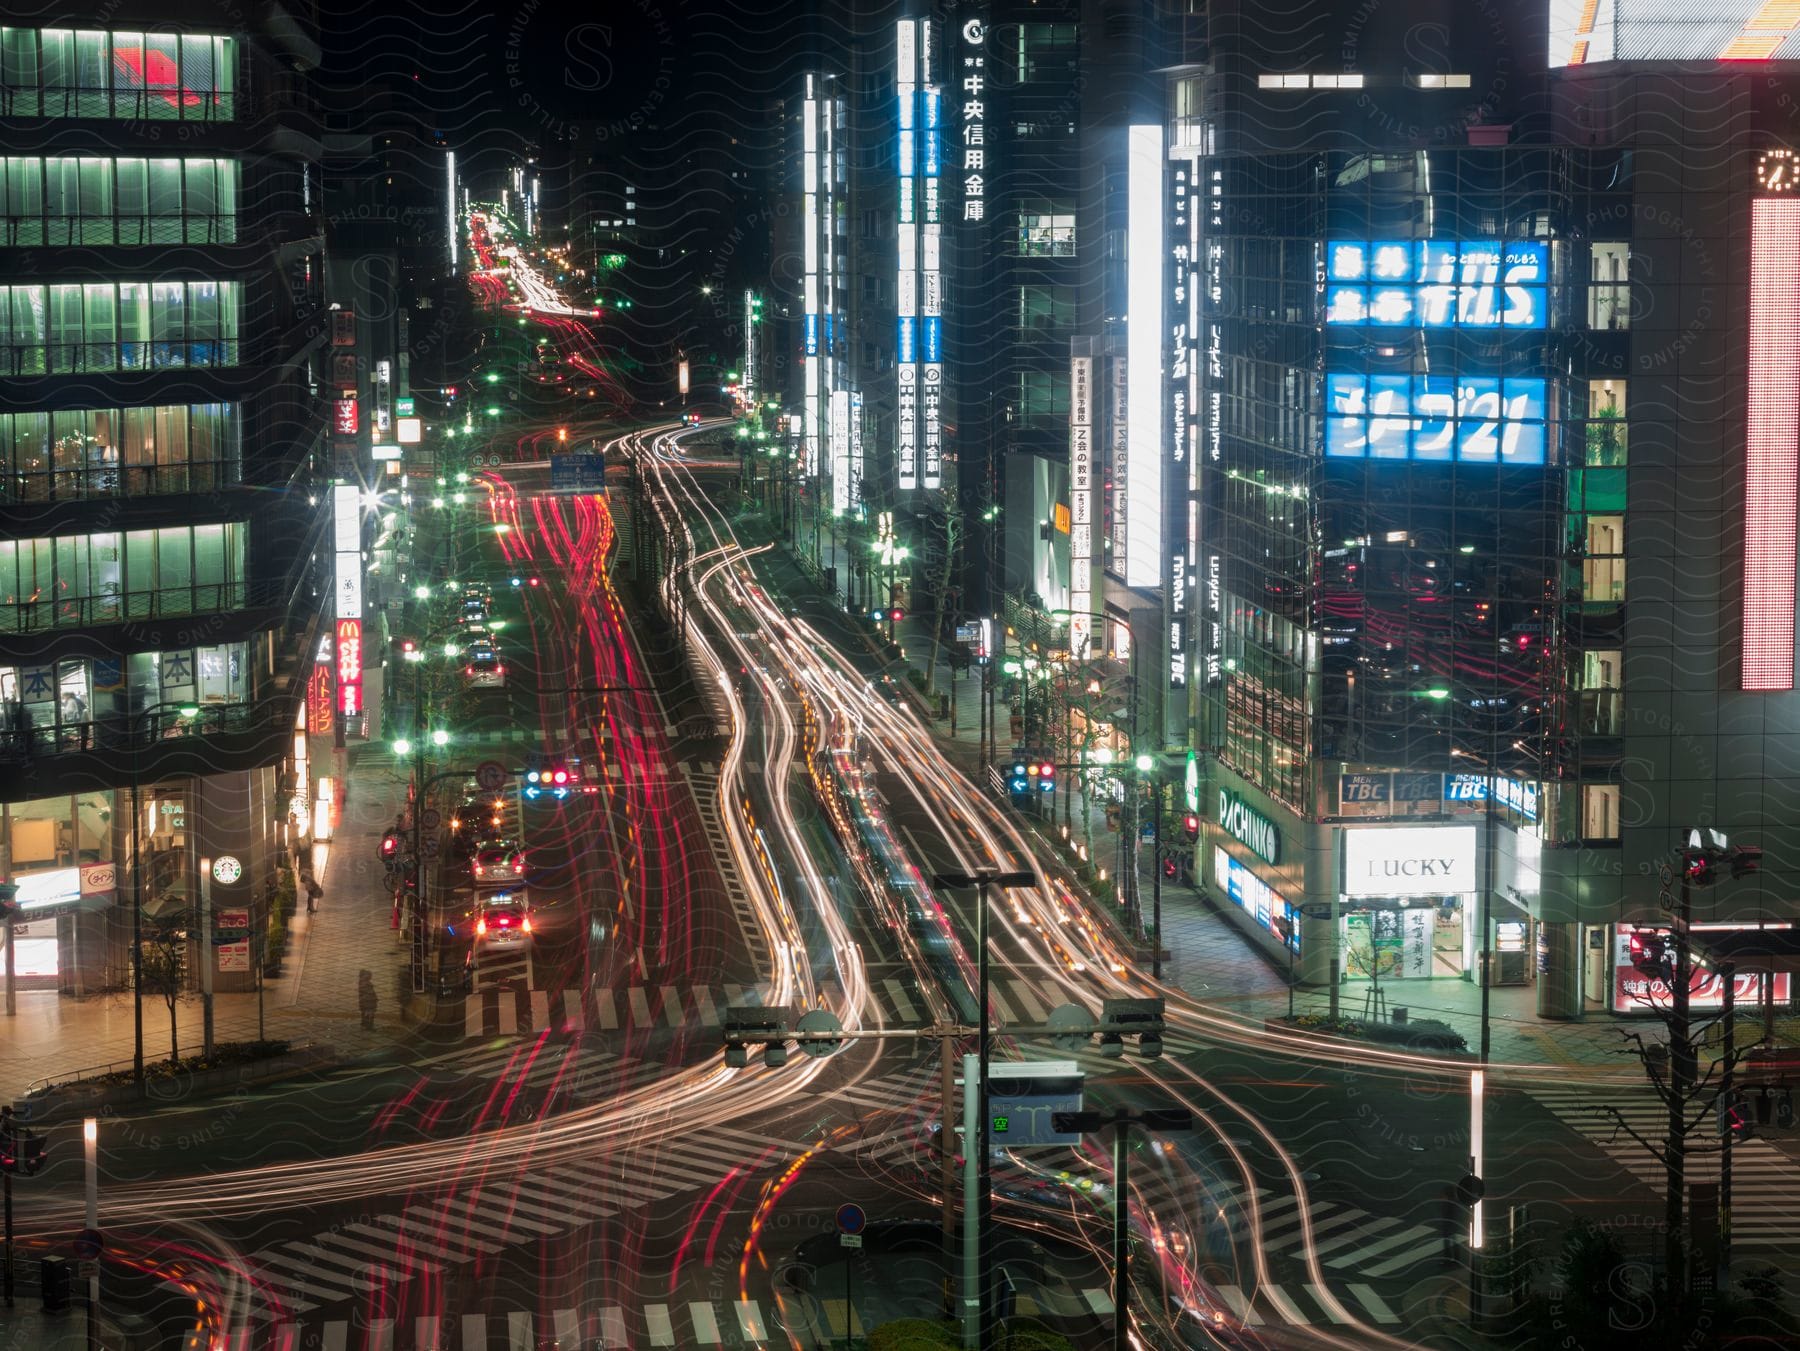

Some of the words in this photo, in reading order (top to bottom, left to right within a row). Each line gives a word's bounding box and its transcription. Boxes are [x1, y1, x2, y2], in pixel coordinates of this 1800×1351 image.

[963, 75, 984, 222] 中央信用金庫
[1077, 430, 1087, 486] Z会の教室
[164, 654, 190, 682] 本
[23, 668, 52, 700] 本
[318, 666, 332, 730] ハートアップ
[1348, 784, 1384, 800] TBC
[1450, 782, 1486, 798] TBC
[1368, 858, 1455, 877] LUCKY
